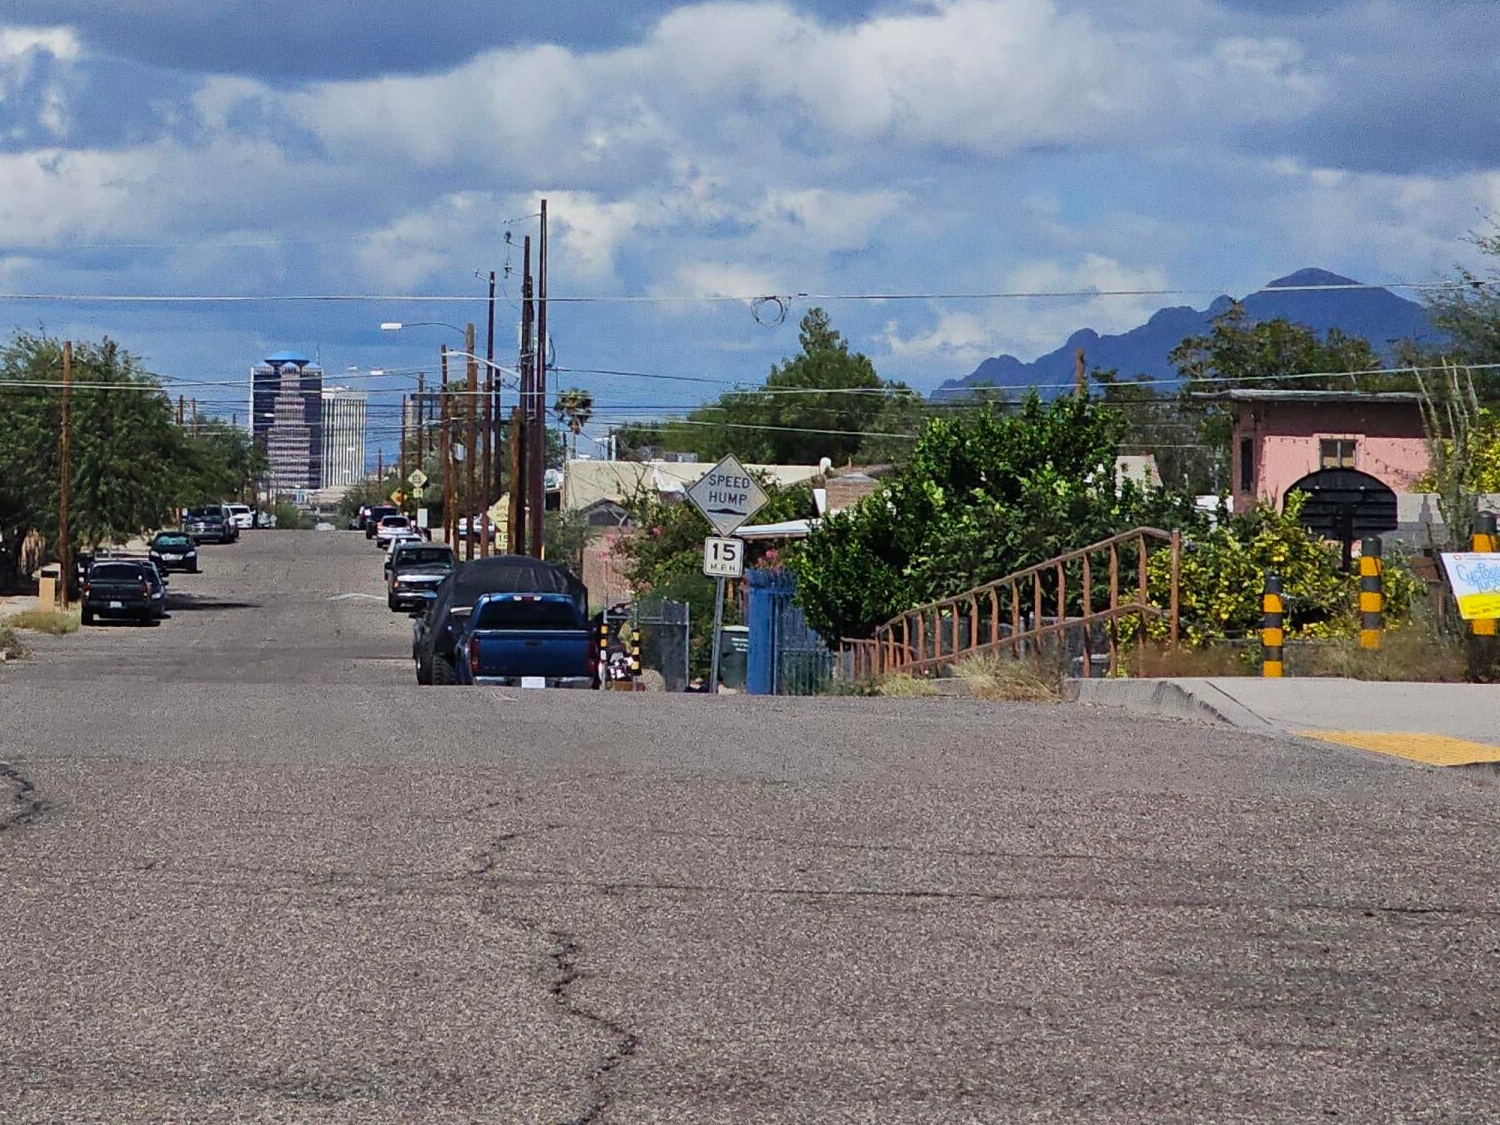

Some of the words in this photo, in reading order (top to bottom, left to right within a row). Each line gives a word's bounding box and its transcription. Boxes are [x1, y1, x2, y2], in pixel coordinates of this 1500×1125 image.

[709, 475, 750, 489] SPEED
[709, 491, 748, 505] HUMP
[713, 542, 736, 561] 15
